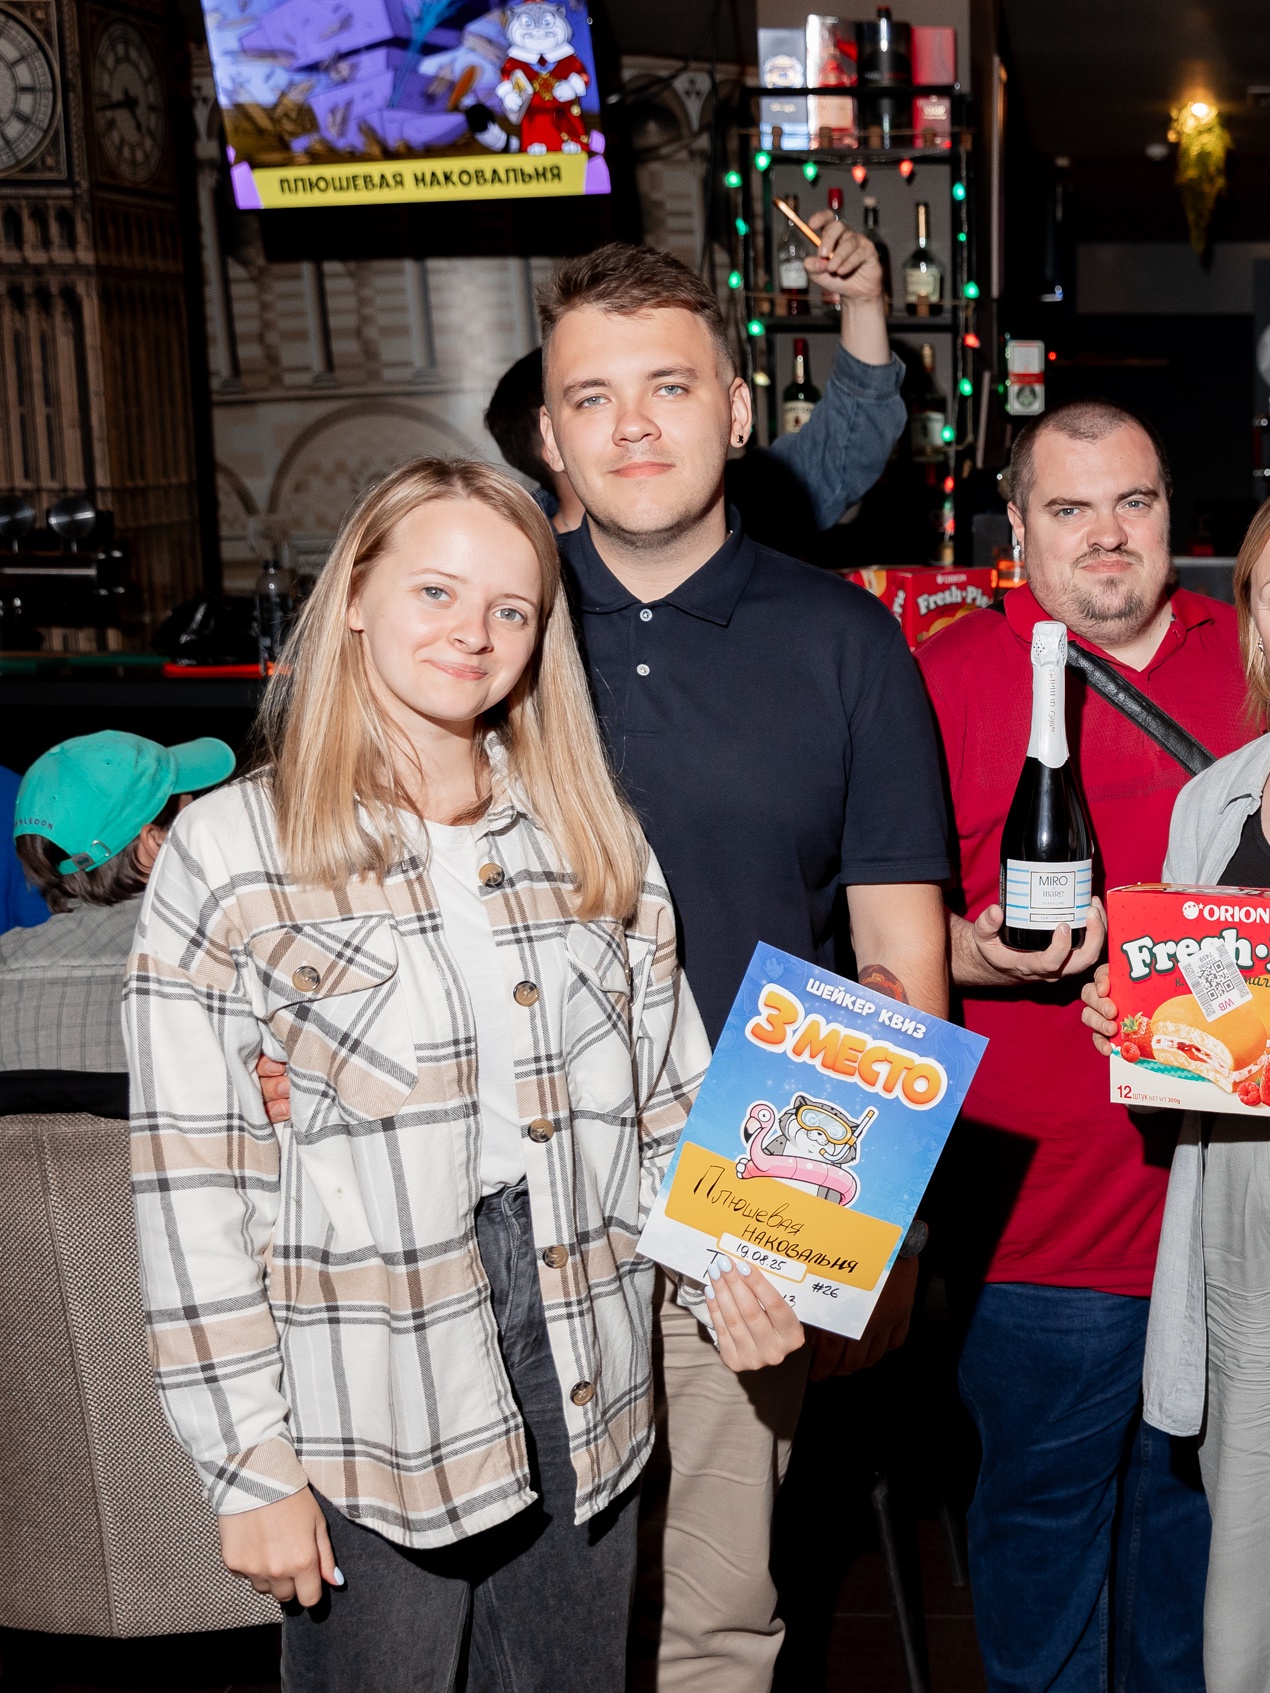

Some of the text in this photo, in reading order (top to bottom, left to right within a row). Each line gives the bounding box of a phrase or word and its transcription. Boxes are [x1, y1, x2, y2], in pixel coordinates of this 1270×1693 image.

[279, 166, 563, 195] ПЛЮШЕВАЯ НАКОВАЛЬНЯ
[1038, 875, 1069, 886] MIRO
[805, 977, 928, 1039] ШЕЙКЕР КВИЗ
[750, 990, 943, 1106] 3 МЕСТО
[1117, 1085, 1132, 1099] 12
[693, 1165, 805, 1236] Плюшевая
[736, 1242, 788, 1271] 19.08.25
[811, 1281, 840, 1299] #26
